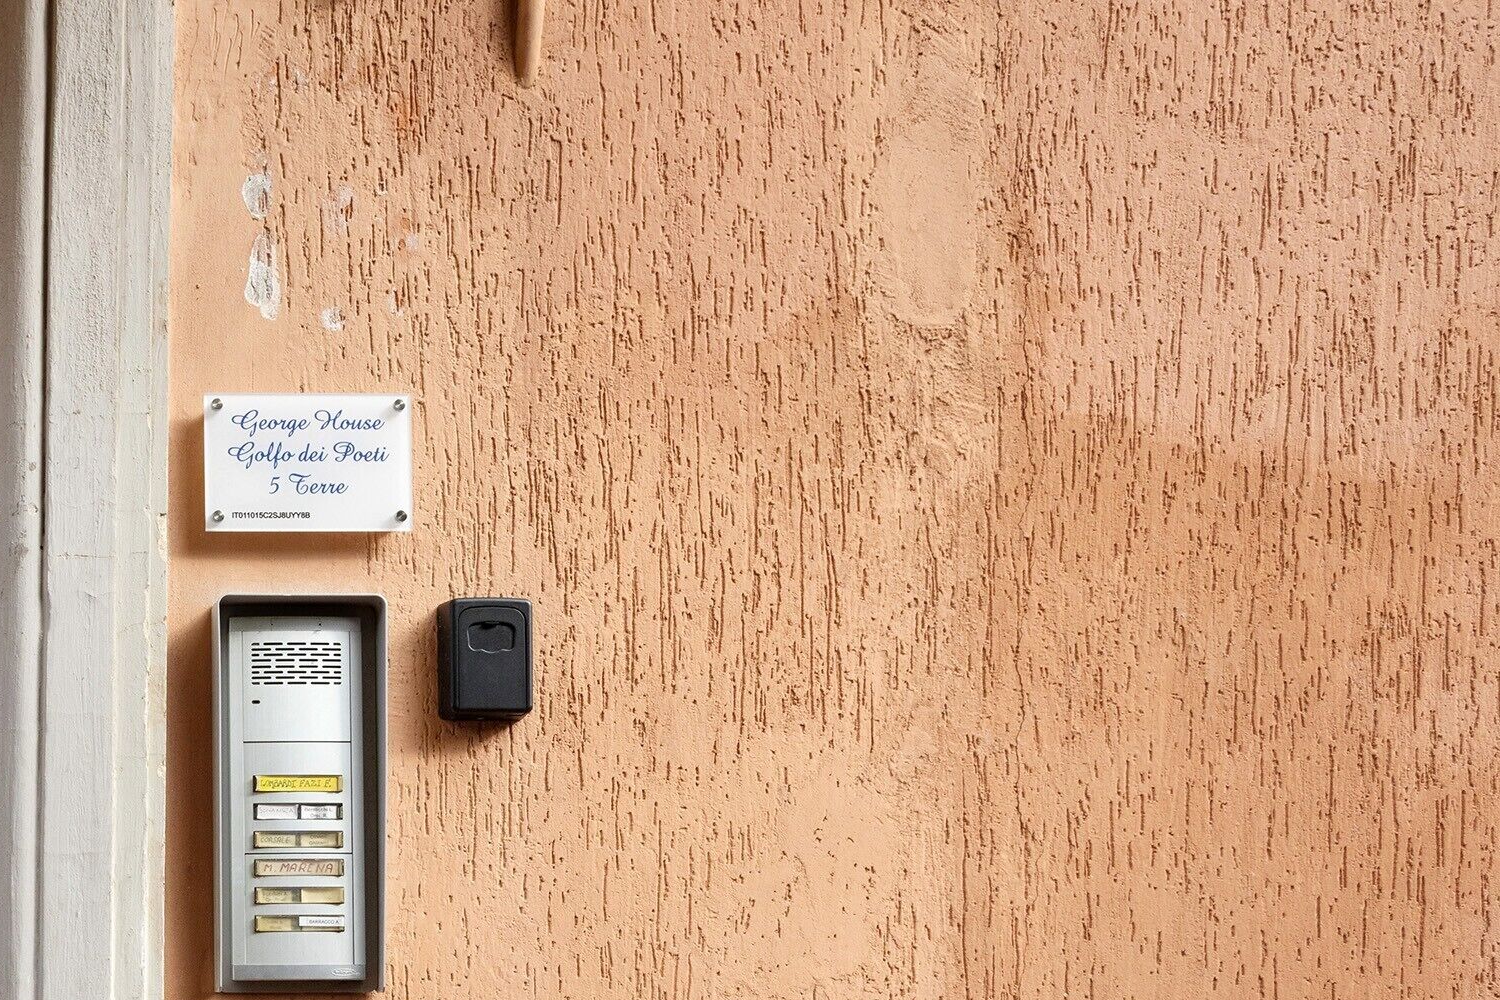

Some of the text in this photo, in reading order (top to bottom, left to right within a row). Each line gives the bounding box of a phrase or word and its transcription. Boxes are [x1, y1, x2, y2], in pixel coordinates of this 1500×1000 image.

[231, 409, 385, 437] George House
[227, 441, 389, 469] Golfo dei Poeti
[269, 473, 349, 494] 5 Terre
